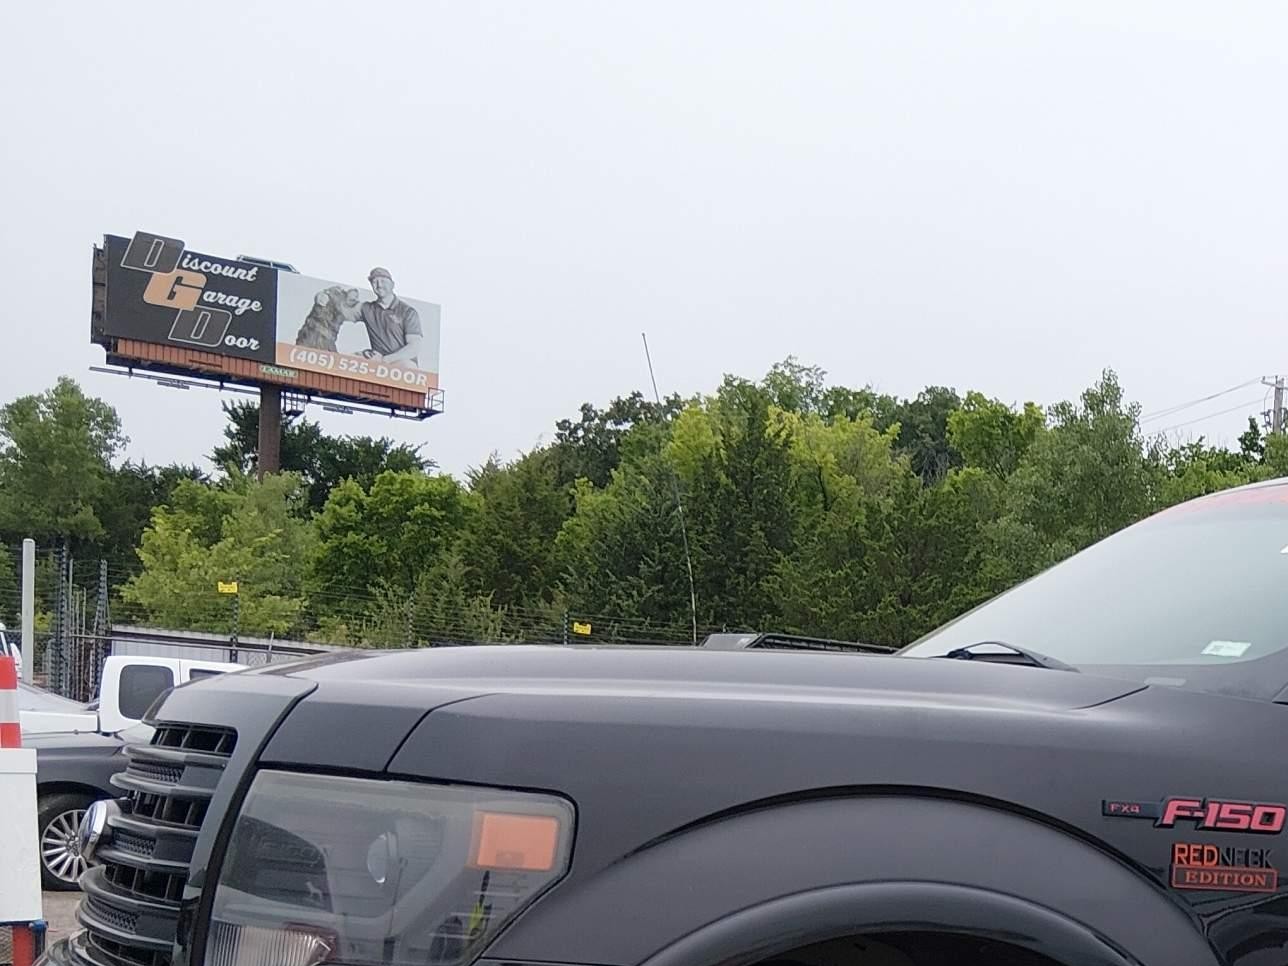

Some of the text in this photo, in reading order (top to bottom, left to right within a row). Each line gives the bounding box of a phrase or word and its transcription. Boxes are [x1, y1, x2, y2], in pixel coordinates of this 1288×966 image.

[121, 231, 258, 283] Discount
[143, 269, 262, 315] Garage
[168, 305, 261, 351] Door
[289, 347, 428, 387] (405) 525-DOOR
[1160, 797, 1286, 832] F-150
[1173, 843, 1273, 868] REDNECK
[1185, 870, 1266, 887] EDITION
